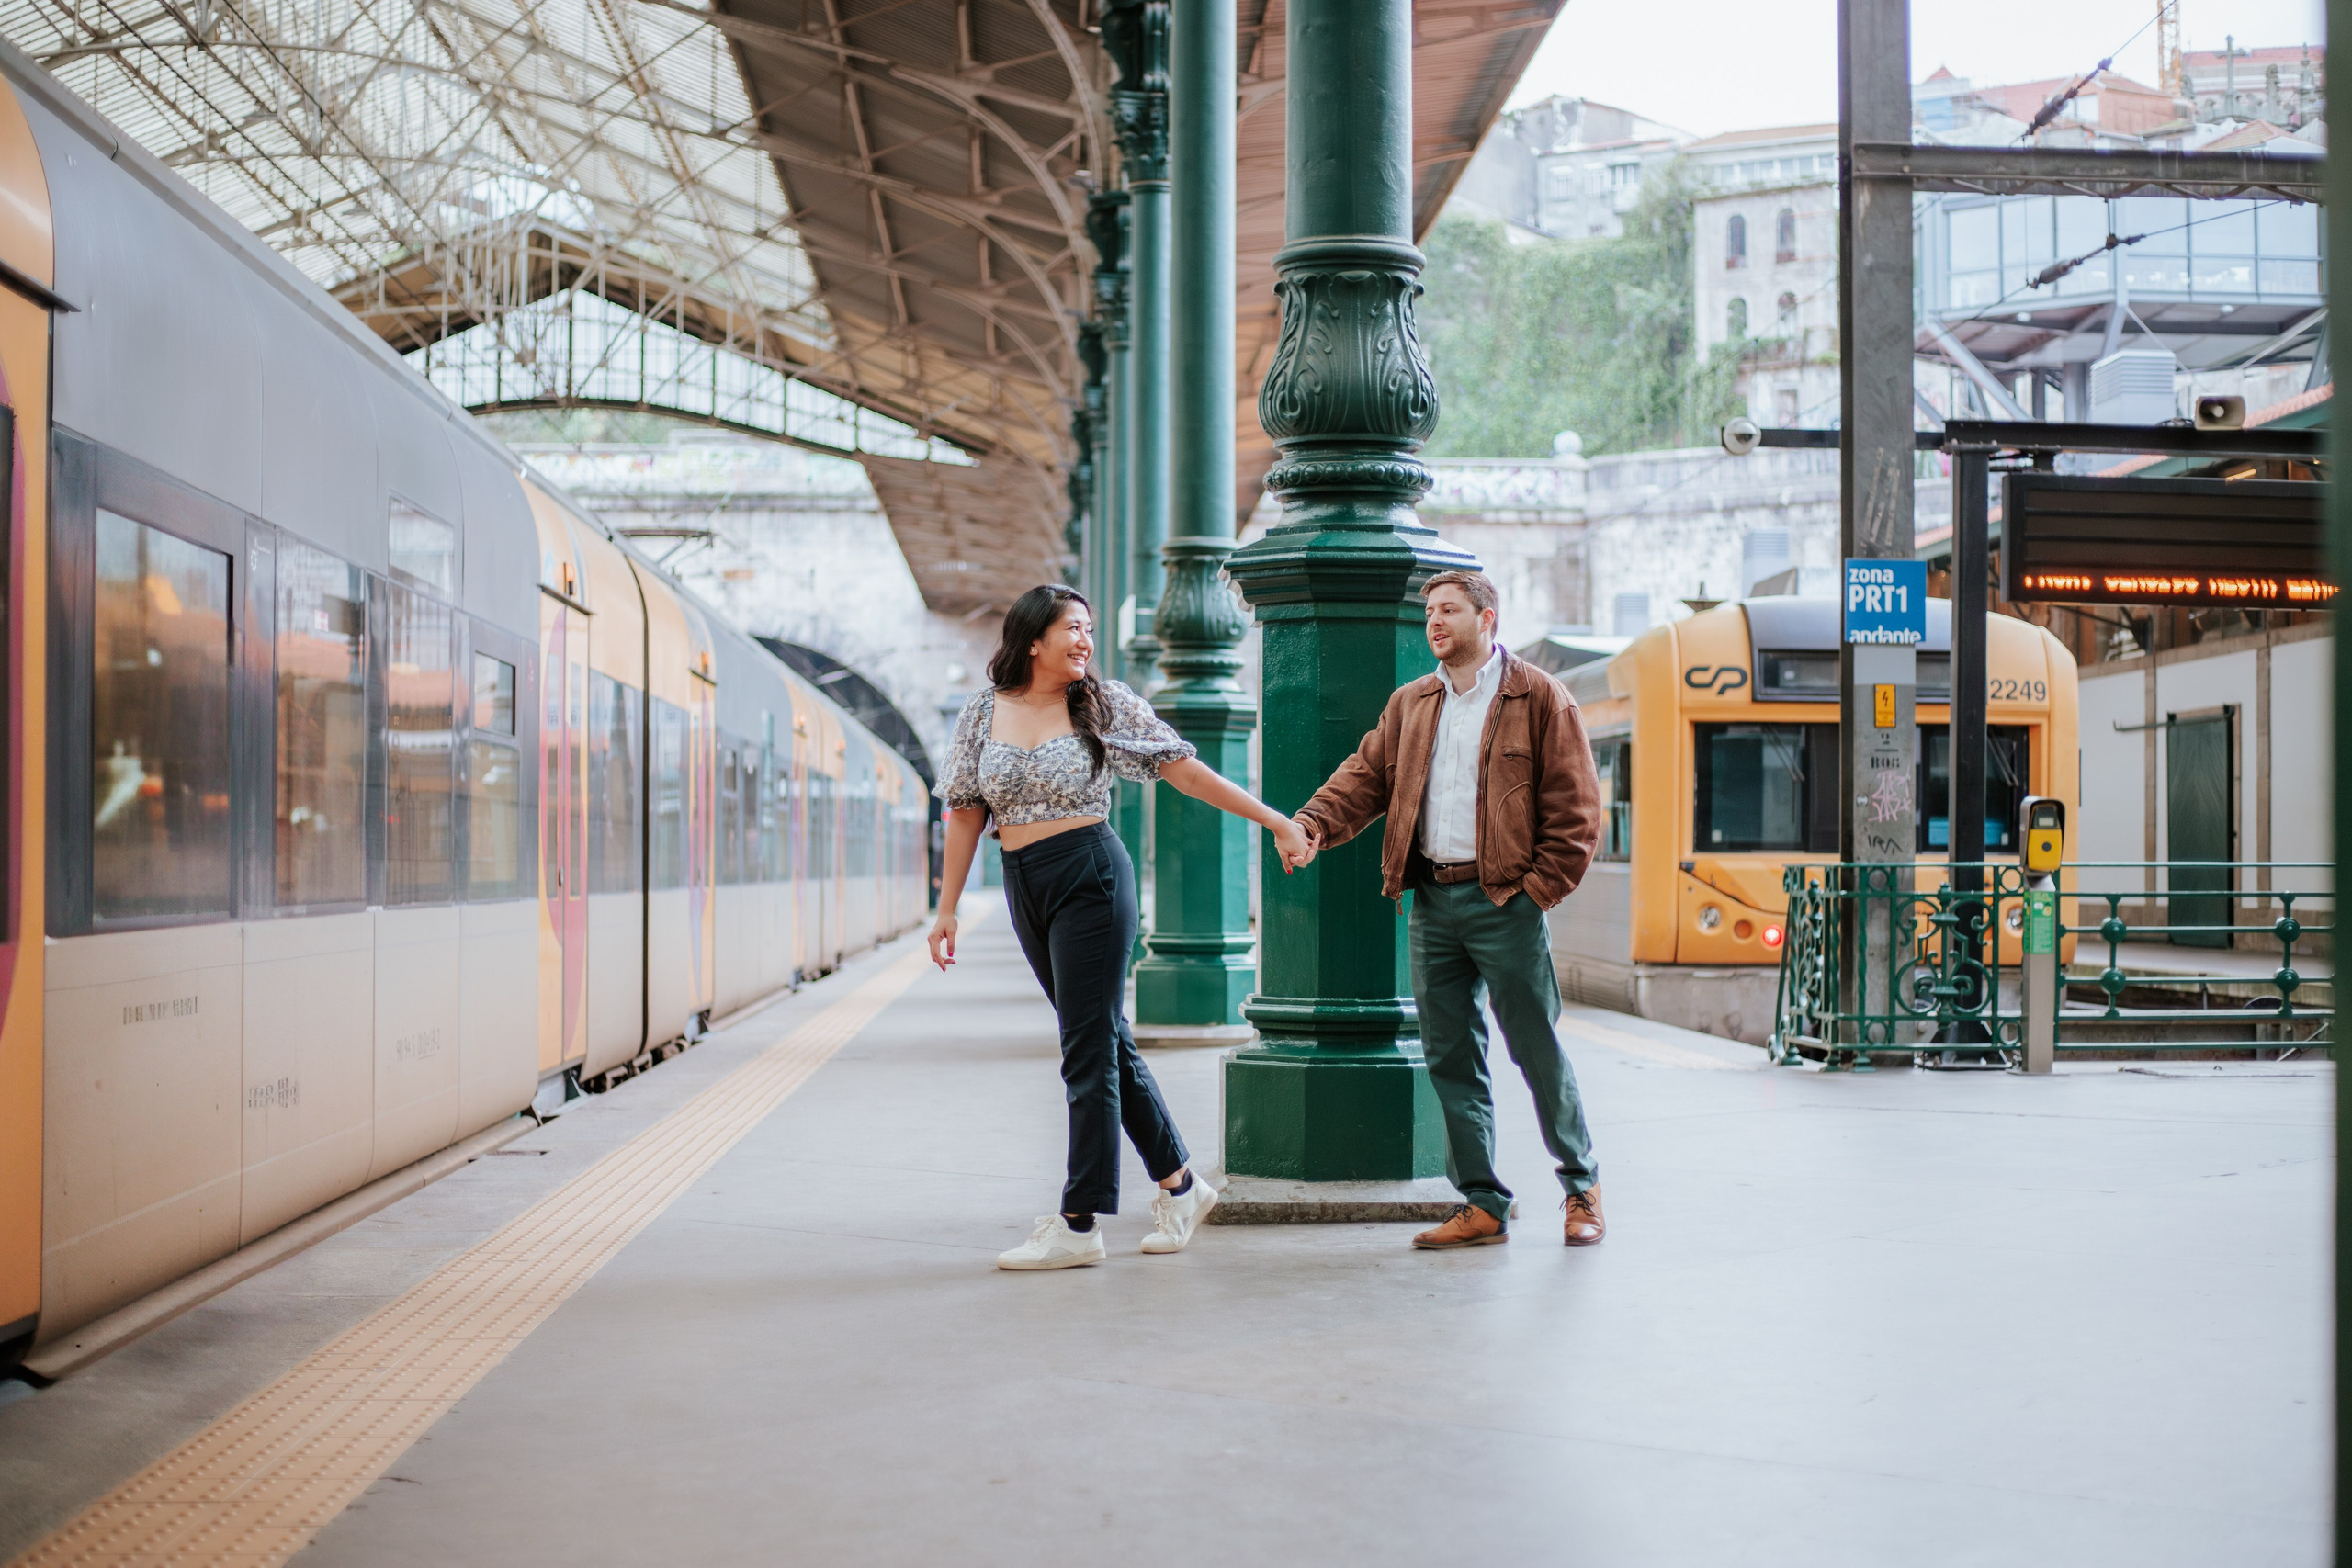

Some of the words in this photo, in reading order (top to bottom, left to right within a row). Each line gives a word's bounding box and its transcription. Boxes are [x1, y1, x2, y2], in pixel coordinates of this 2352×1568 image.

[1849, 567, 1894, 584] zona
[1849, 583, 1908, 613] PRT1
[1849, 624, 1922, 644] andante
[1990, 678, 2047, 702] 2249
